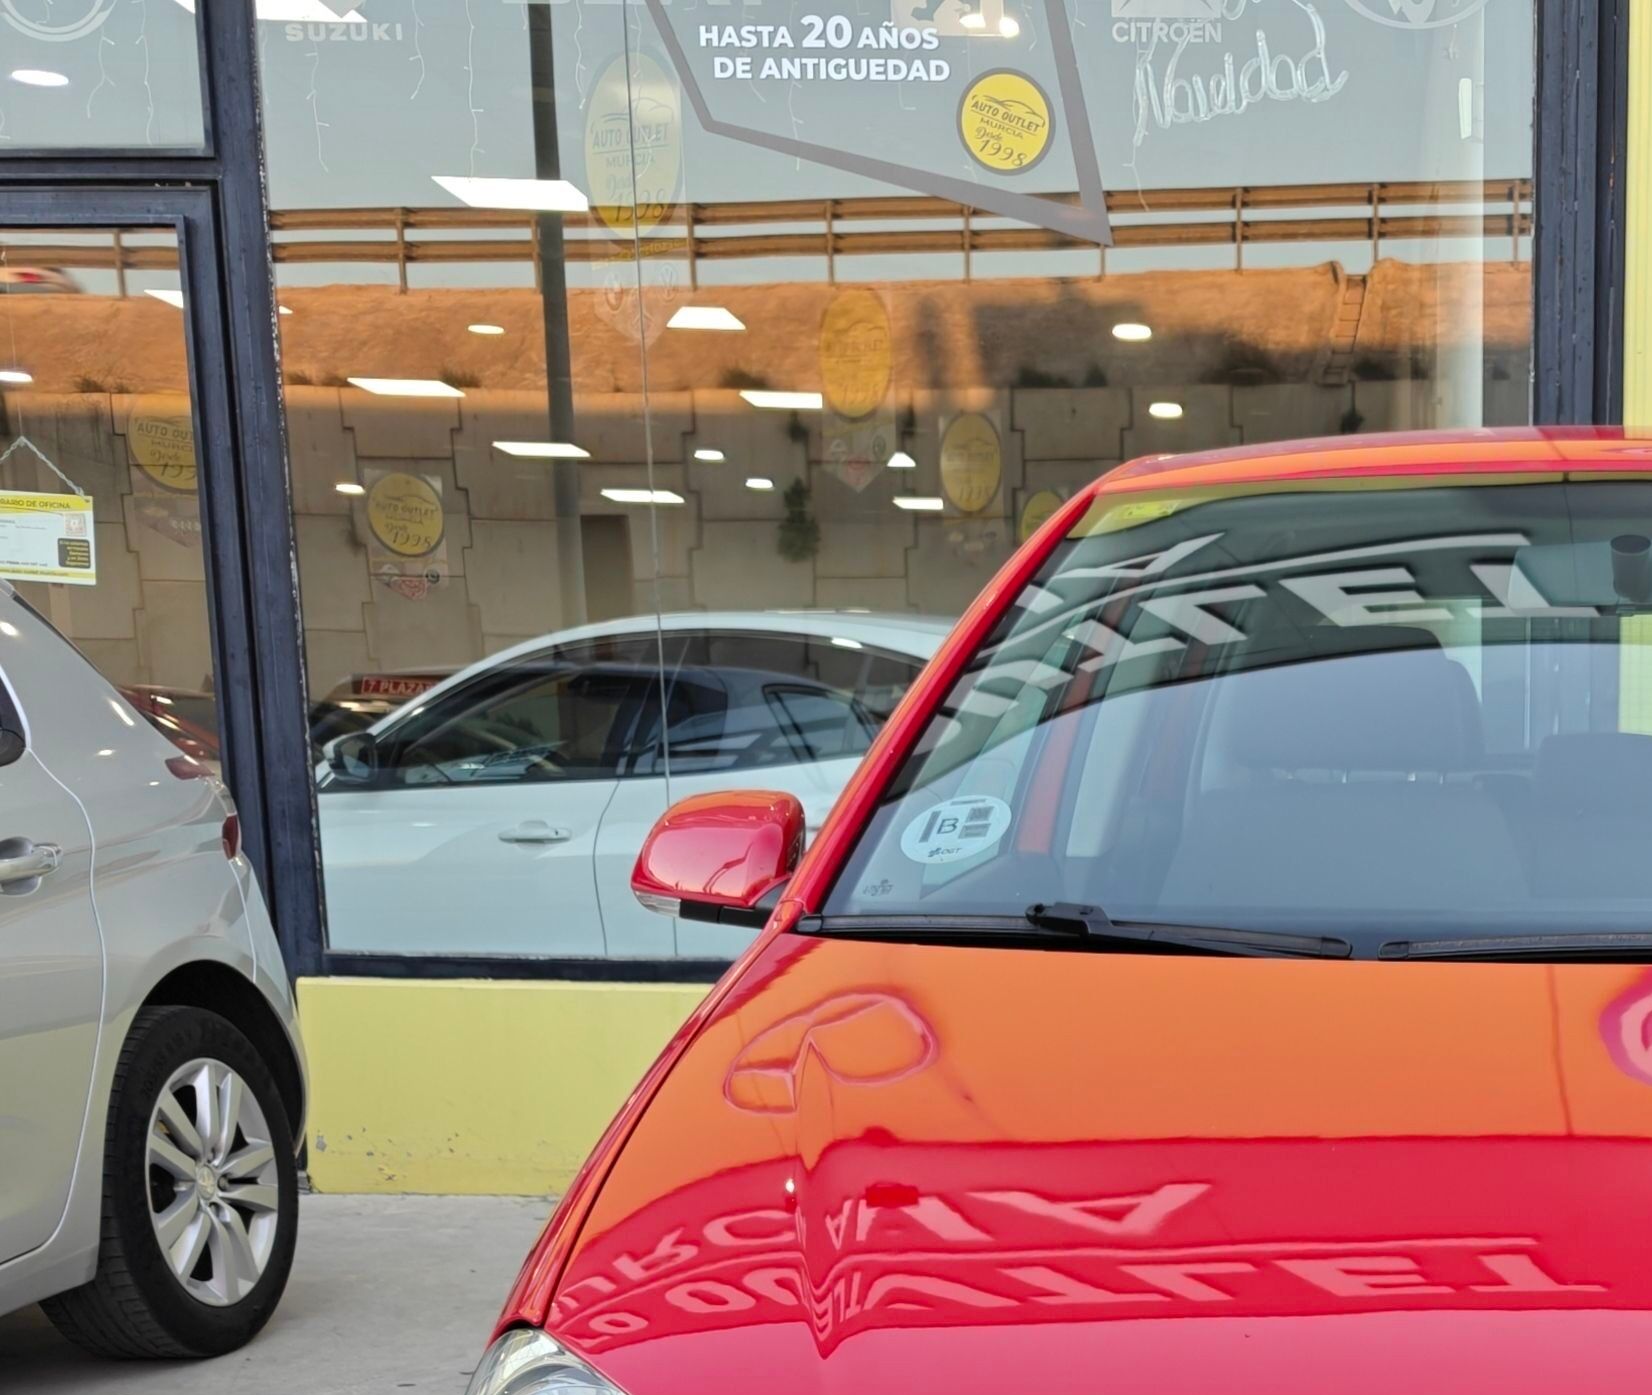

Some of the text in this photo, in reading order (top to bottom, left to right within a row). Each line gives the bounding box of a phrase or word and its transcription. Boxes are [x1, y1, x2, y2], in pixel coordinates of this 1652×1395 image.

[285, 23, 402, 42] SUZUKI
[699, 15, 939, 50] HASTA 20 AÑOS
[1112, 18, 1222, 43] CITROËN
[713, 58, 950, 82] DE ANTIGUEDAD
[971, 100, 1041, 133] AUTO OUTLET
[980, 117, 1024, 139] MURCIA
[592, 127, 621, 148] AUTO
[979, 139, 1028, 167] 1998
[368, 679, 378, 694] 7
[936, 818, 960, 834] B
